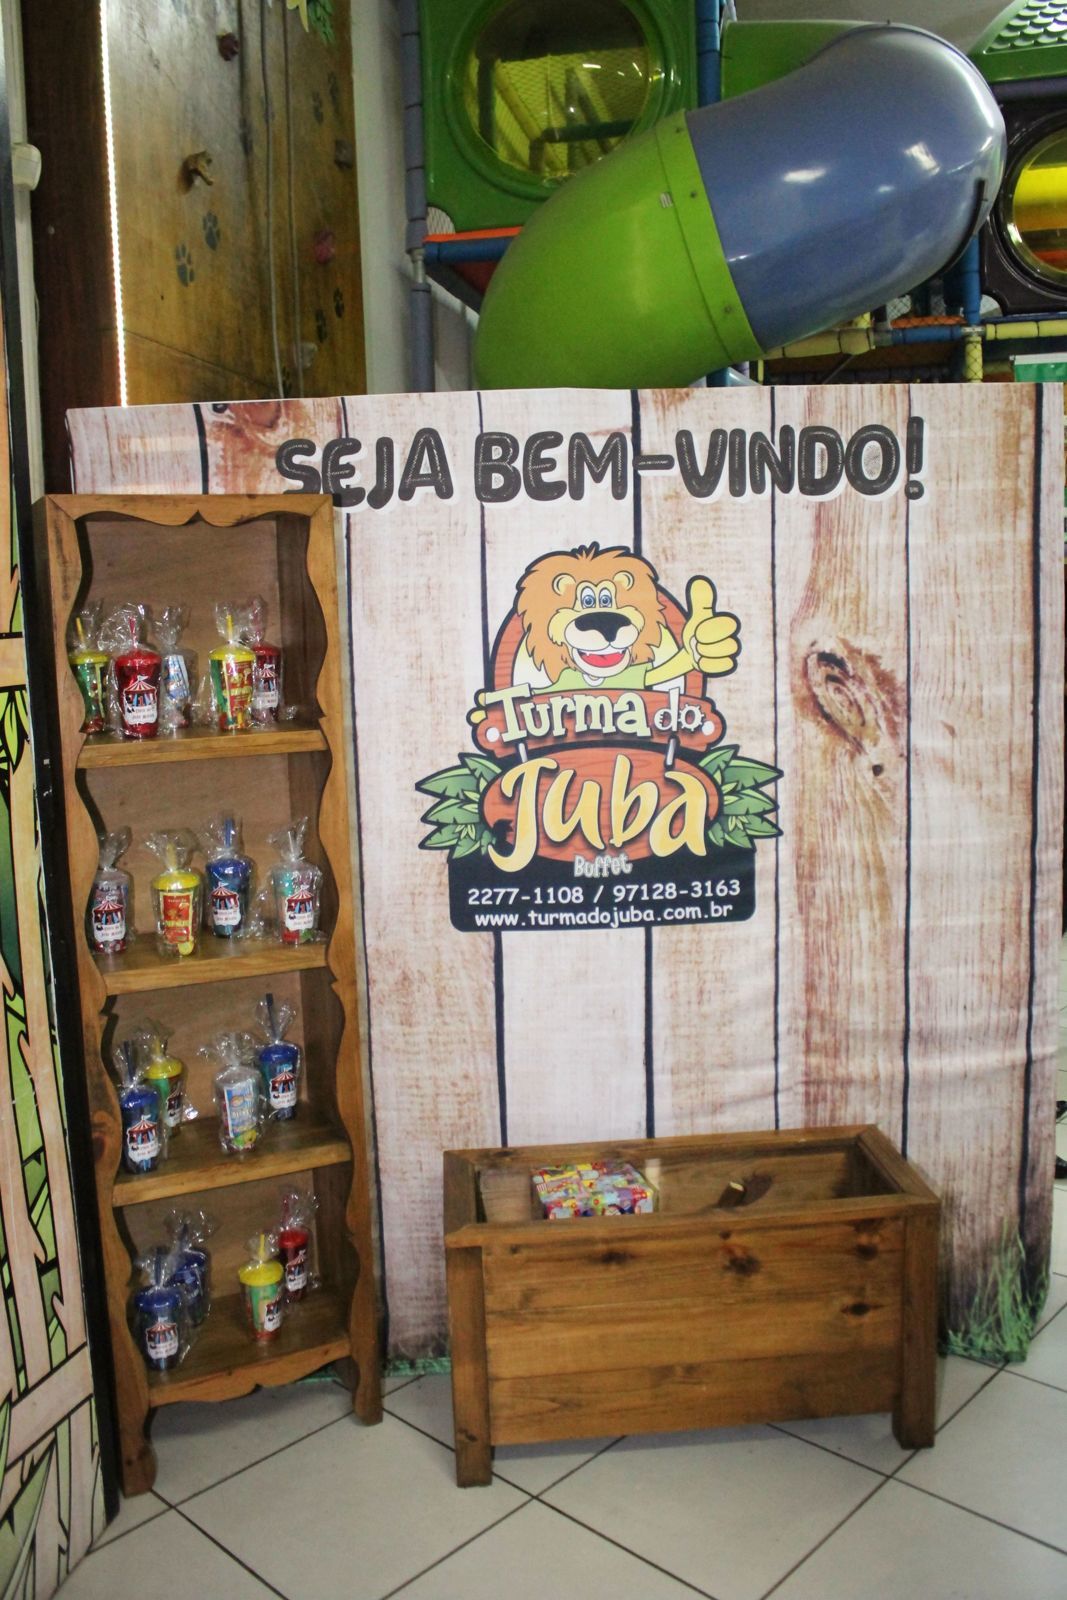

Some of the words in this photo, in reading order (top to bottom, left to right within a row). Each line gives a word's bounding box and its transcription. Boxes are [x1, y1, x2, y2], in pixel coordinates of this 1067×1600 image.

[275, 427, 454, 510] SEJA
[474, 416, 925, 503] BEM-VINDO!
[486, 683, 652, 742] Turma
[654, 687, 704, 732] do
[487, 754, 708, 873] Juba
[573, 855, 633, 878] Buffet
[468, 887, 584, 905] 2277-1108
[593, 885, 603, 903] /
[612, 879, 741, 903] 97128-3163
[475, 902, 733, 928] www.turmadojuba.com.br
